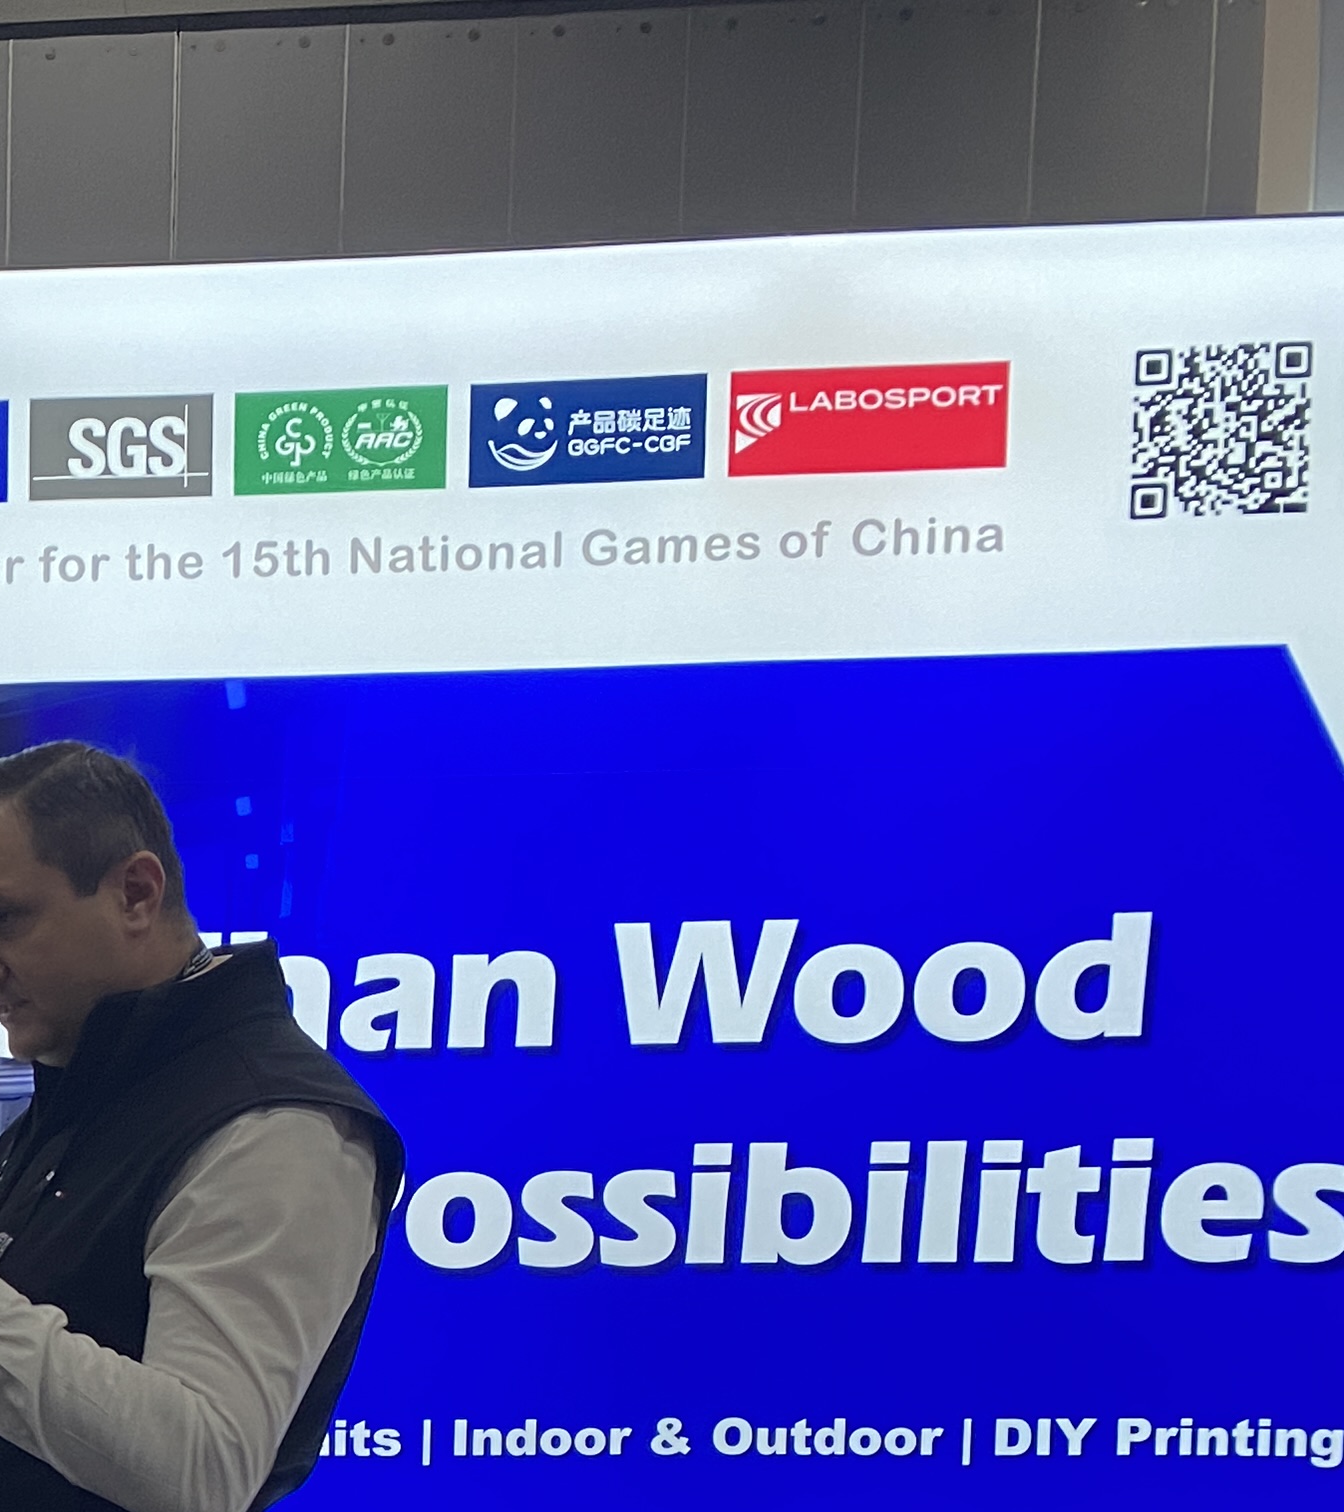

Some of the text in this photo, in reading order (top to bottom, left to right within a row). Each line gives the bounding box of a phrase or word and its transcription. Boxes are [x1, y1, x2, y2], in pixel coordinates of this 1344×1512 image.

[567, 406, 692, 436] 产品碳足迹
[789, 384, 1004, 412] LABOSPORT
[68, 417, 186, 478] SGS
[354, 431, 414, 450] AAC
[39, 546, 110, 584] for
[125, 543, 203, 582] the
[222, 539, 330, 579] 15th
[350, 531, 563, 575] National
[581, 528, 760, 567] Games
[779, 520, 832, 559] of
[852, 516, 1004, 556] China
[614, 912, 1153, 1046] Wood
[396, 1138, 1344, 1270] ossibilities
[319, 1419, 402, 1457] its
[453, 1418, 632, 1457] Indoor
[651, 1418, 692, 1456] &
[713, 1416, 944, 1456] Outdoor
[994, 1417, 1097, 1456] DIY
[1116, 1417, 1344, 1468] Printing
